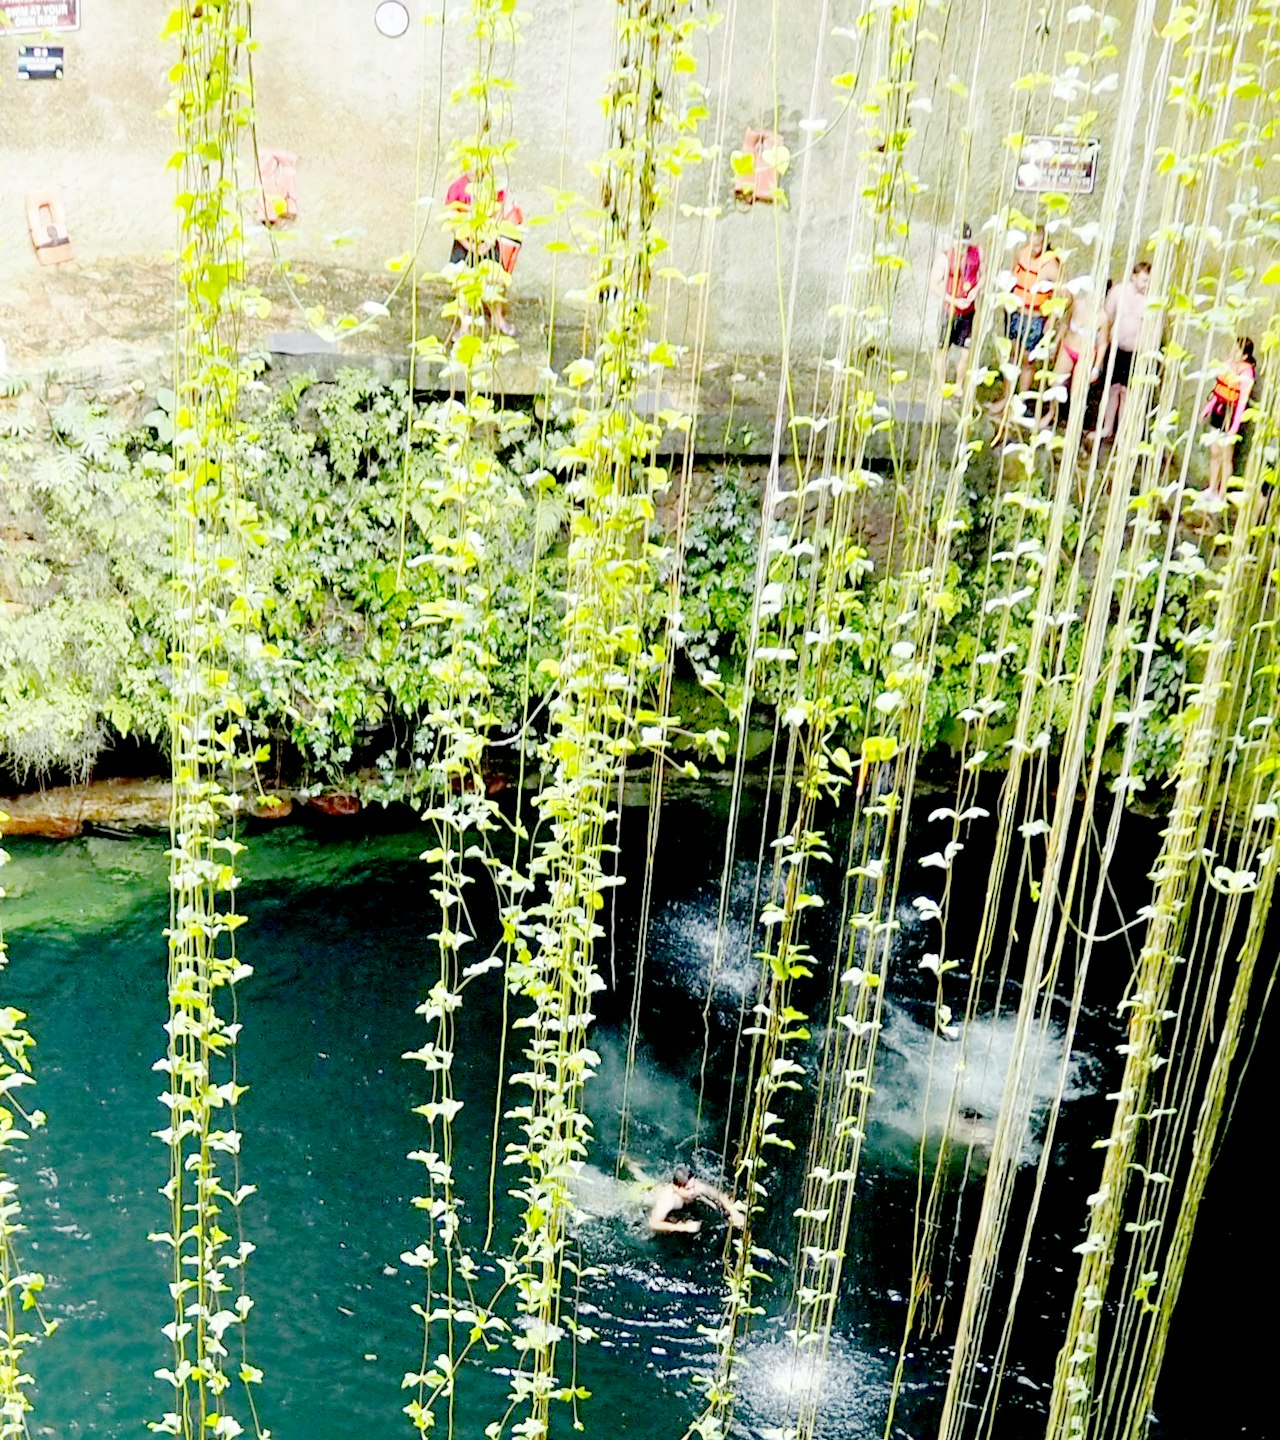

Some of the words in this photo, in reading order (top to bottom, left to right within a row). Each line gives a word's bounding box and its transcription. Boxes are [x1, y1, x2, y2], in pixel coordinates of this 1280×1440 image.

[5, 6, 28, 18] SWIM
[30, 5, 42, 17] AT
[42, 4, 68, 16] YOUR
[15, 16, 36, 28] OWN
